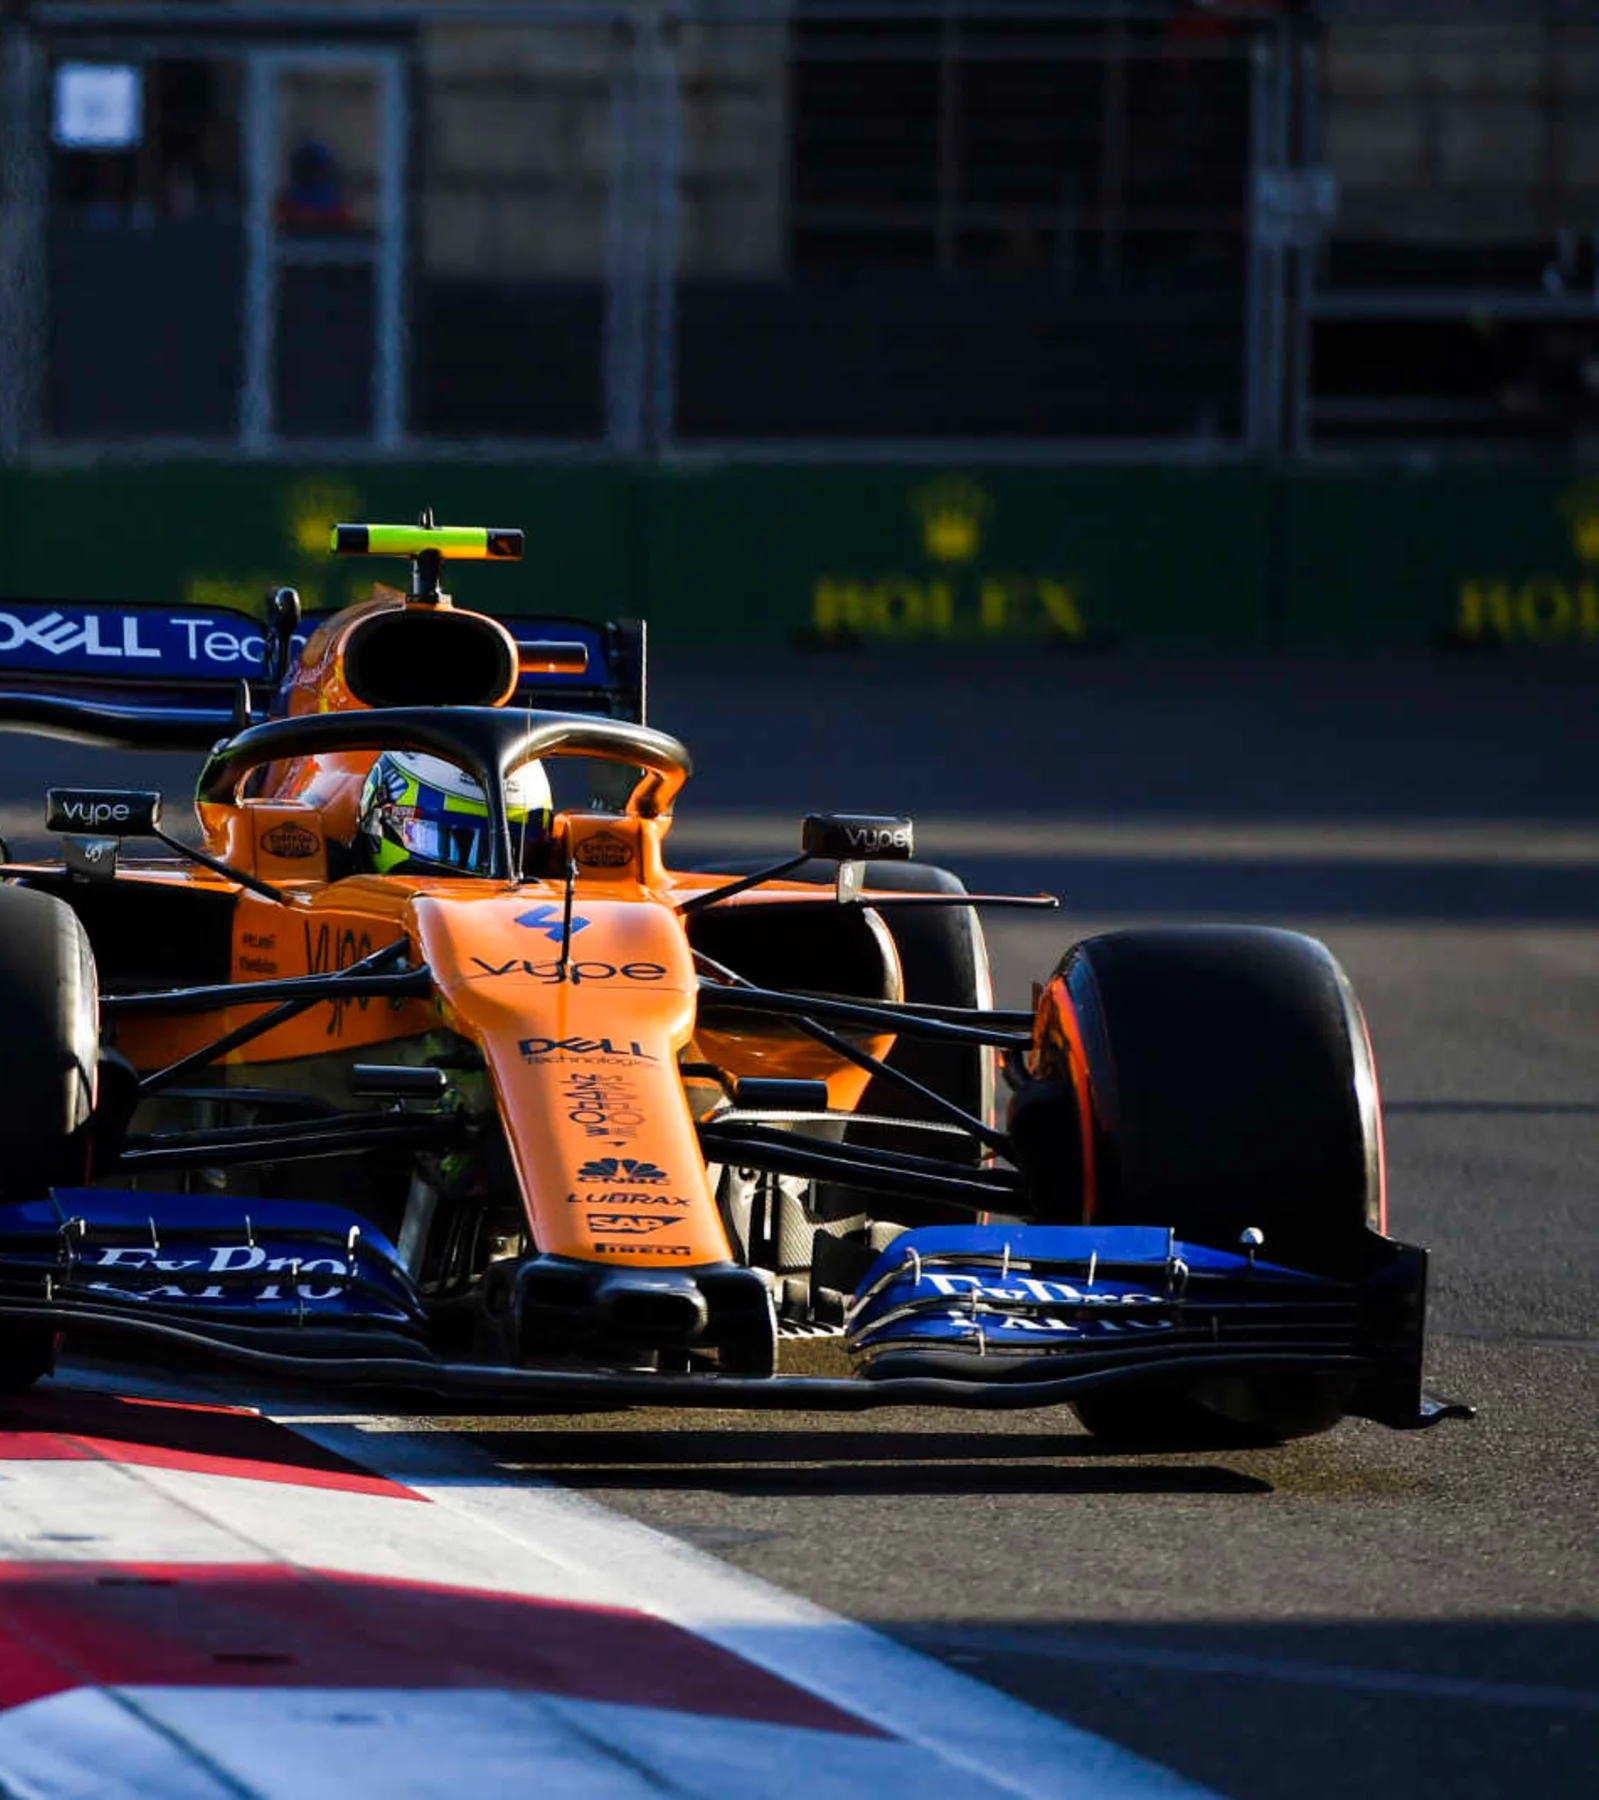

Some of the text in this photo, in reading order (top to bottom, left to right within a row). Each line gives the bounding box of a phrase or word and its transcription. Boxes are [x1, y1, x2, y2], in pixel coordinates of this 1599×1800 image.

[813, 577, 1086, 637] ROLEX
[62, 801, 130, 826] vype
[514, 904, 591, 943] 4
[469, 957, 667, 985] vype
[518, 1036, 659, 1062] DELL
[577, 1175, 671, 1186] CNBC
[566, 1192, 691, 1206] LUBRAX
[588, 1214, 665, 1232] SAP
